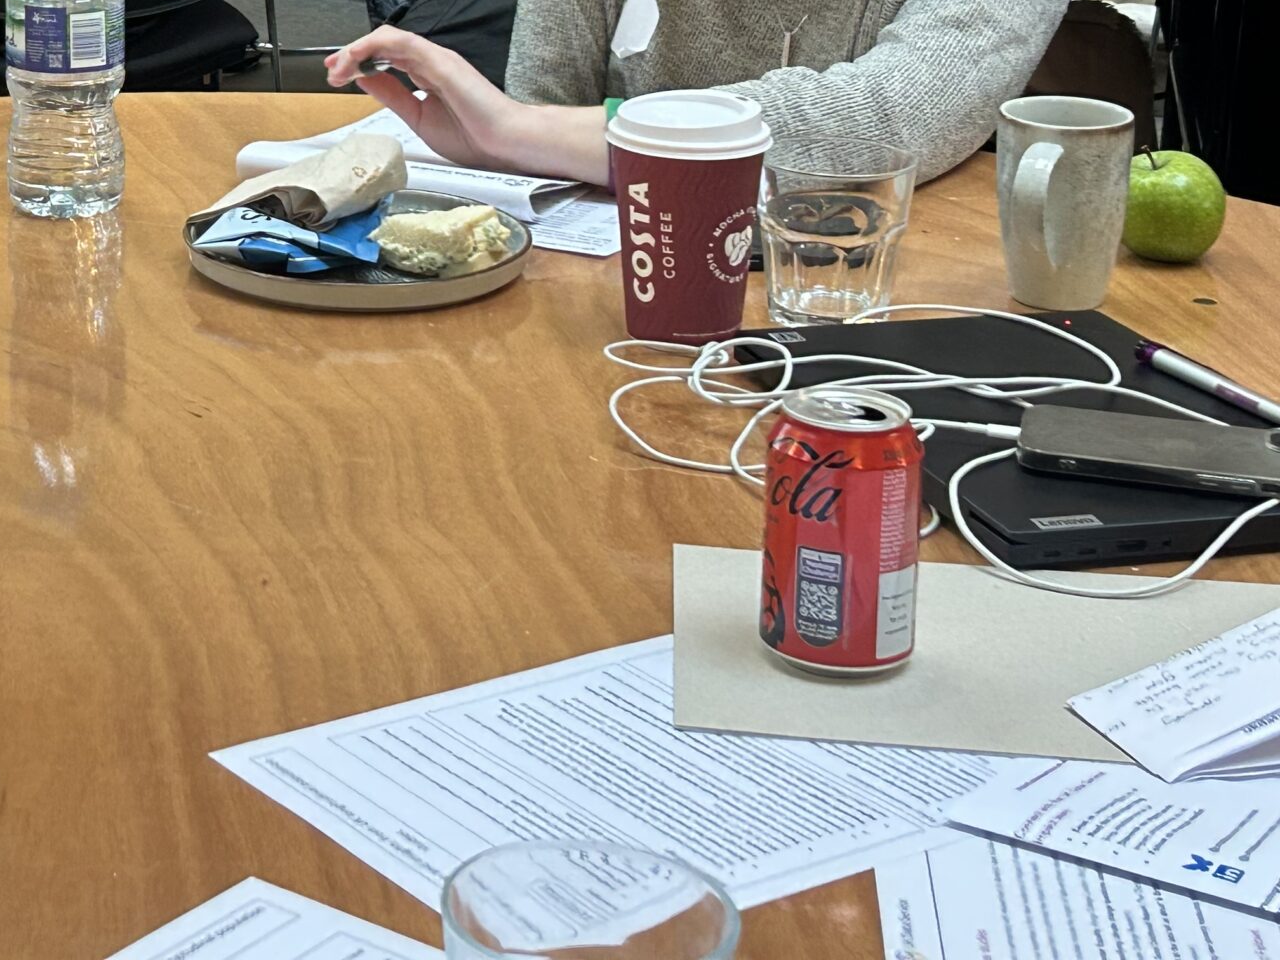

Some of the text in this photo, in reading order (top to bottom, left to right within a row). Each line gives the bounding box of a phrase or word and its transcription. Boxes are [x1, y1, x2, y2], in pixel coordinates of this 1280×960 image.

[628, 182, 655, 303] COSTA
[660, 212, 676, 279] COFFEE
[1038, 518, 1096, 527] Lenovo
